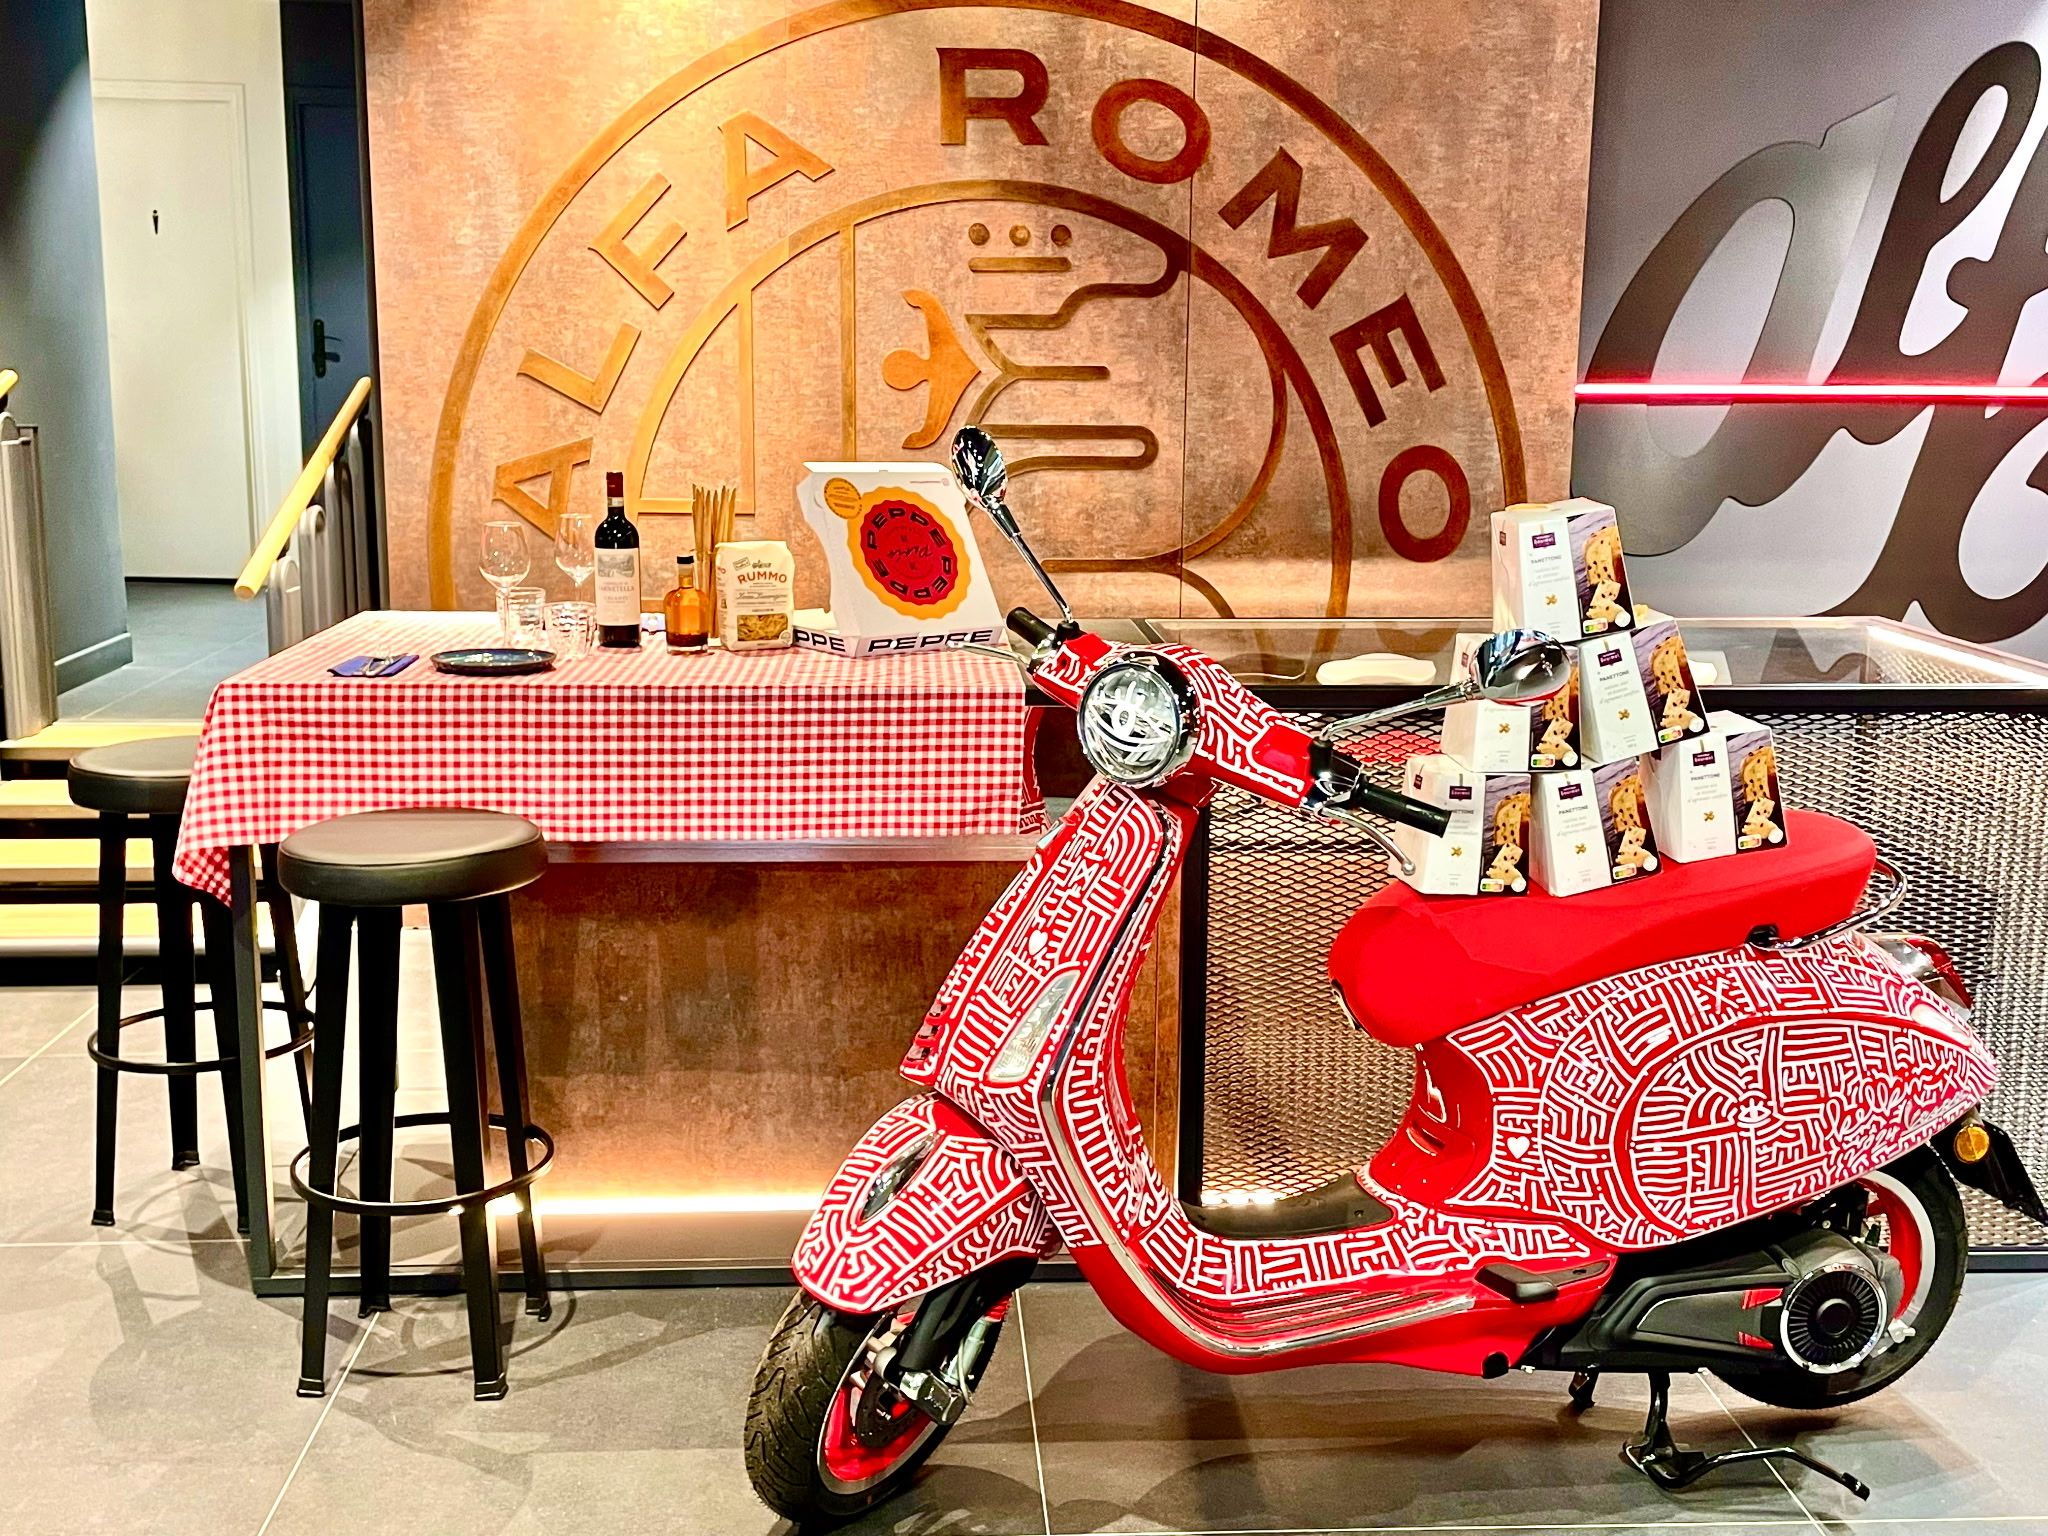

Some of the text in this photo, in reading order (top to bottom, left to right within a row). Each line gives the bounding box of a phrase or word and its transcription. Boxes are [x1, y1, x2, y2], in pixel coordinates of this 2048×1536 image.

[491, 47, 1471, 563] ALFA ROMEO
[737, 571, 788, 585] RUMMO
[793, 629, 993, 653] PPE PEPPE
